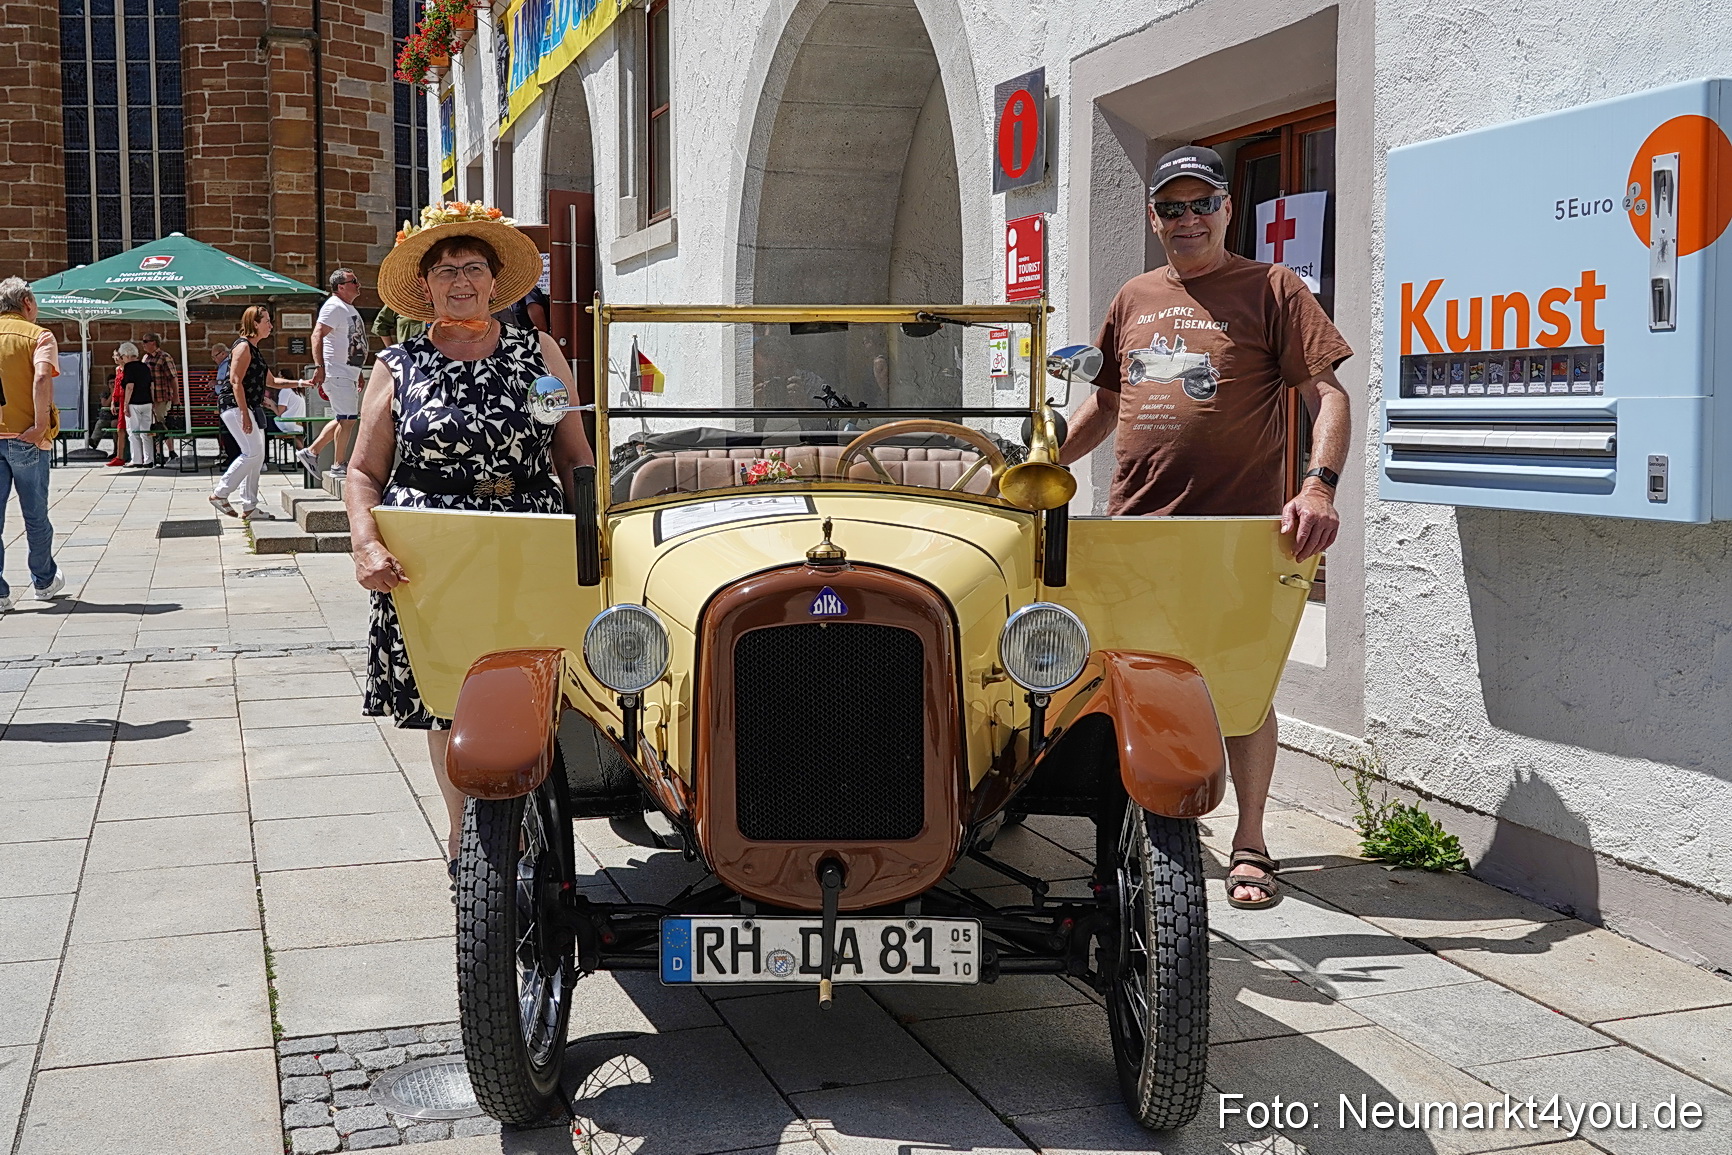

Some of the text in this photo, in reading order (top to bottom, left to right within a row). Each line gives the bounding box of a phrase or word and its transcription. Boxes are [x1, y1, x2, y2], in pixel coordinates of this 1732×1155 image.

[1172, 156, 1197, 166] WERKE
[1180, 163, 1214, 174] EISENACH
[119, 270, 176, 278] Neumarkter
[1018, 261, 1041, 275] TOURIST
[105, 273, 184, 284] Lammsbräu
[1137, 306, 1195, 325] DIXI WERKE
[1400, 269, 1607, 356] Kunst
[1173, 318, 1229, 332] EISENACH
[730, 498, 781, 508] 264
[812, 594, 842, 615] DIXI
[951, 928, 972, 942] 05
[696, 927, 761, 975] RH
[879, 925, 940, 975] 81
[672, 956, 683, 971] D
[953, 962, 972, 976] 10
